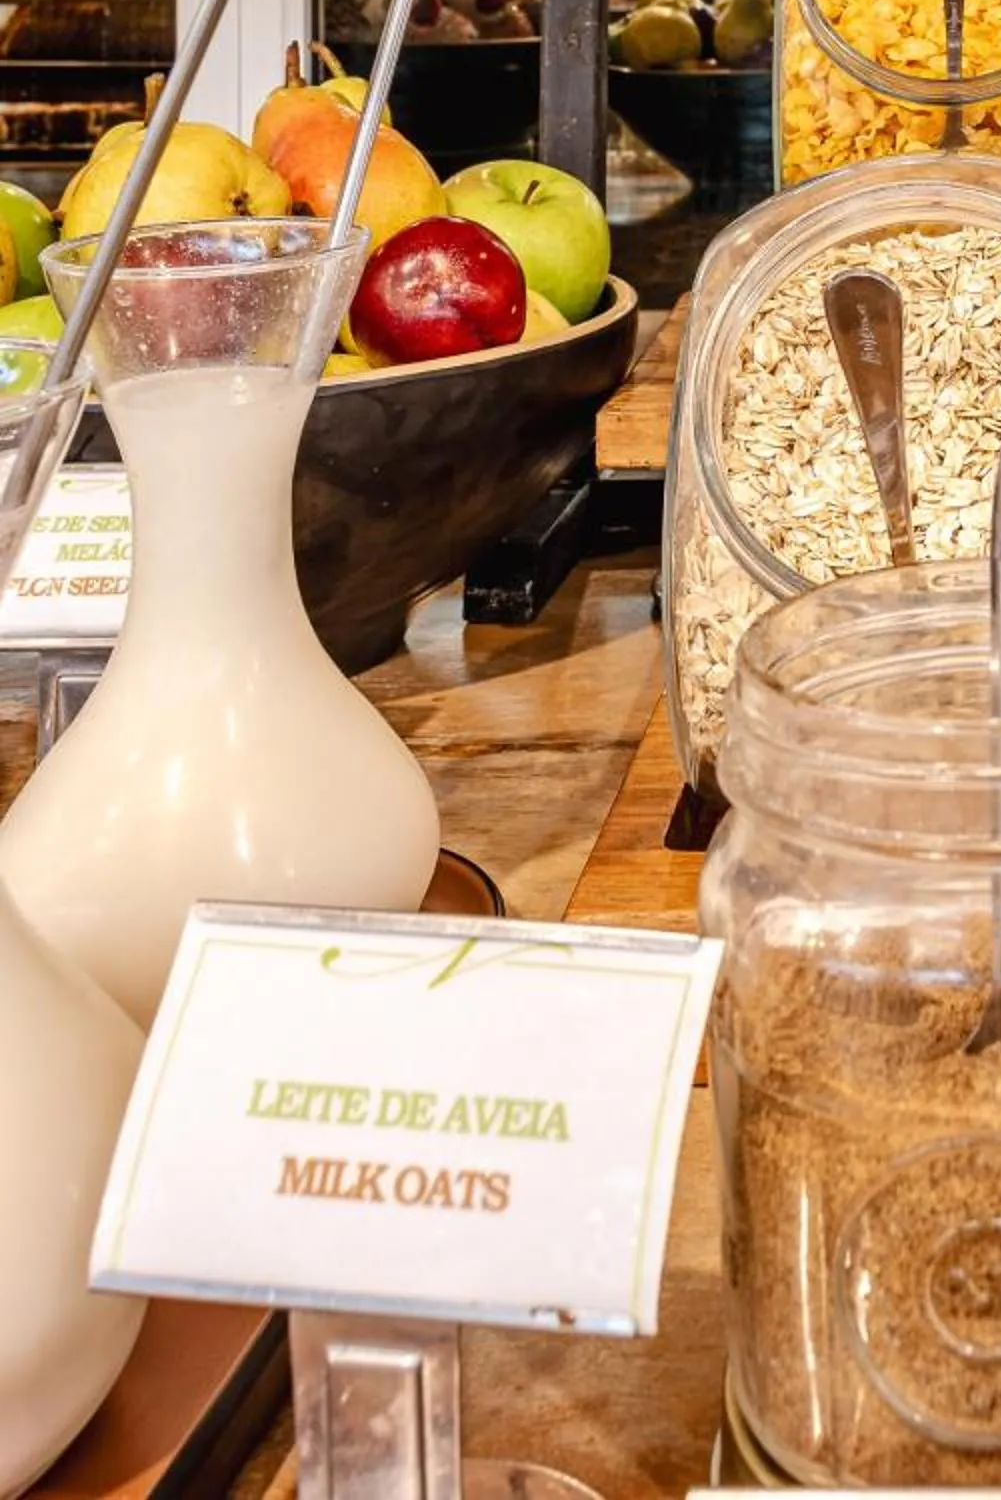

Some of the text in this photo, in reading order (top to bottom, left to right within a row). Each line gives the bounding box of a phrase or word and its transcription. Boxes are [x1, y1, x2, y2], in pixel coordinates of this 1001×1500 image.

[50, 515, 87, 533] DE
[246, 1079, 571, 1143] LEITE DE AVEIA
[275, 1156, 511, 1213] MILK OATS
